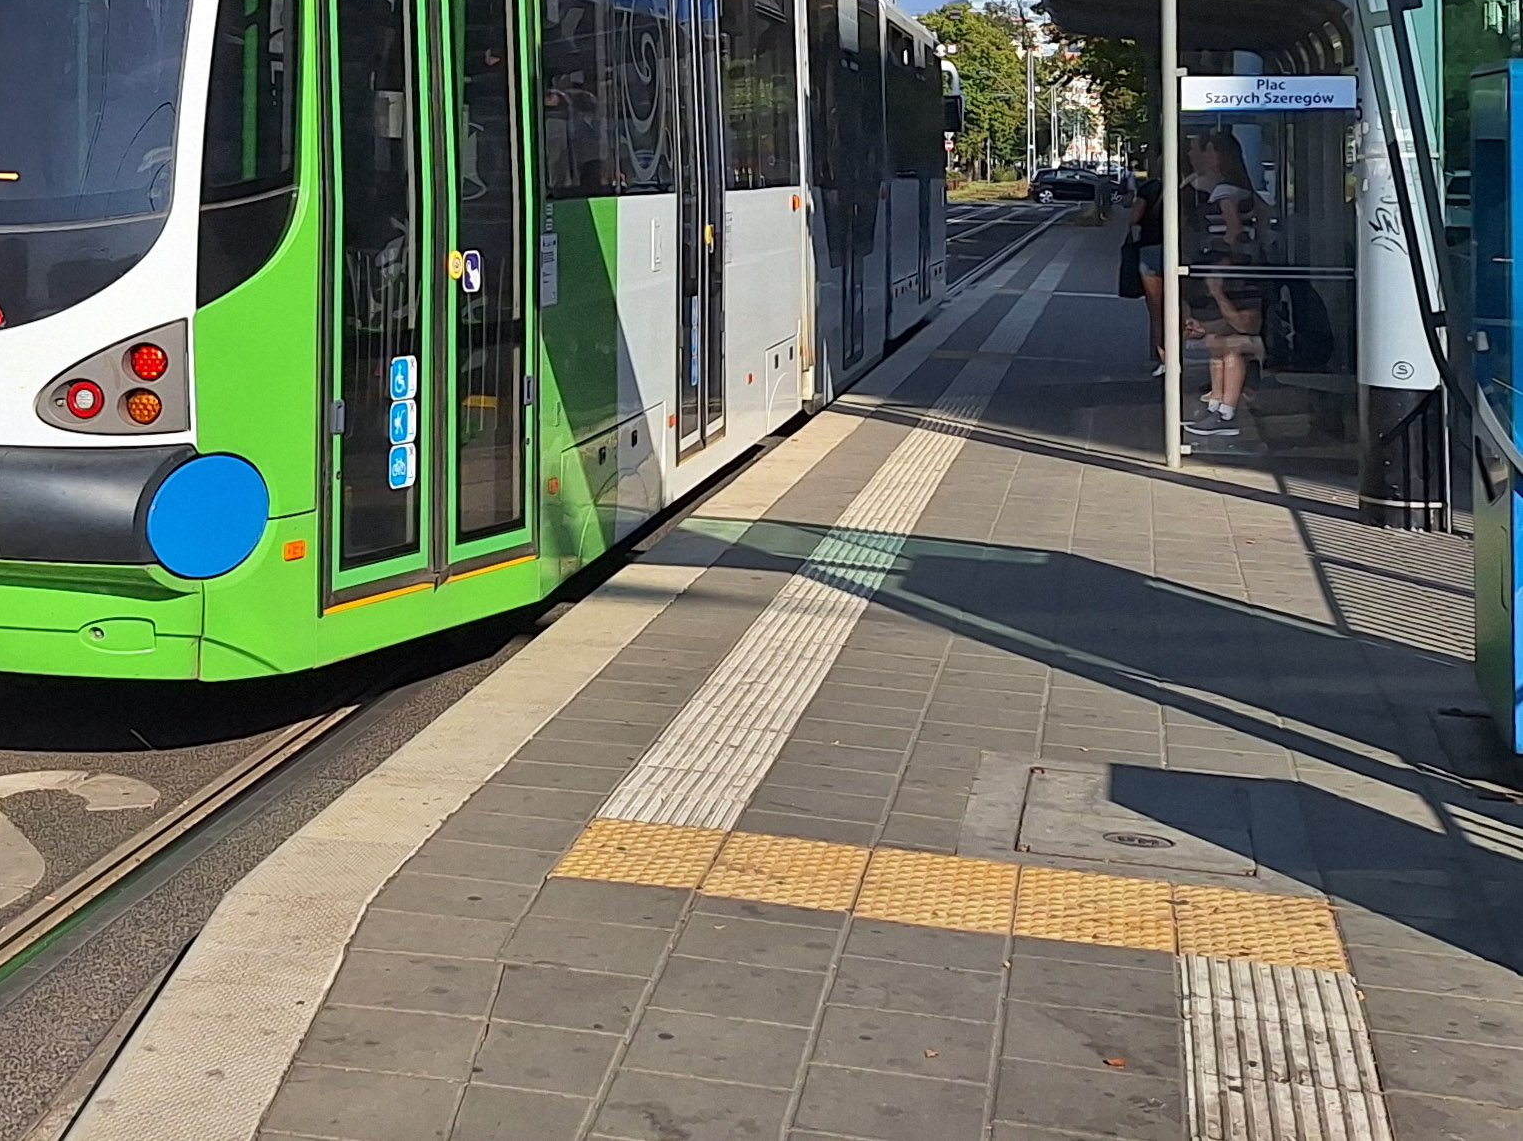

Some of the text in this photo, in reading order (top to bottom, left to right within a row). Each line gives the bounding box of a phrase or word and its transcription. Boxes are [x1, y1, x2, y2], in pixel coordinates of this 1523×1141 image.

[1256, 79, 1286, 91] Plac
[1205, 92, 1334, 106] Szarych Szeregów
